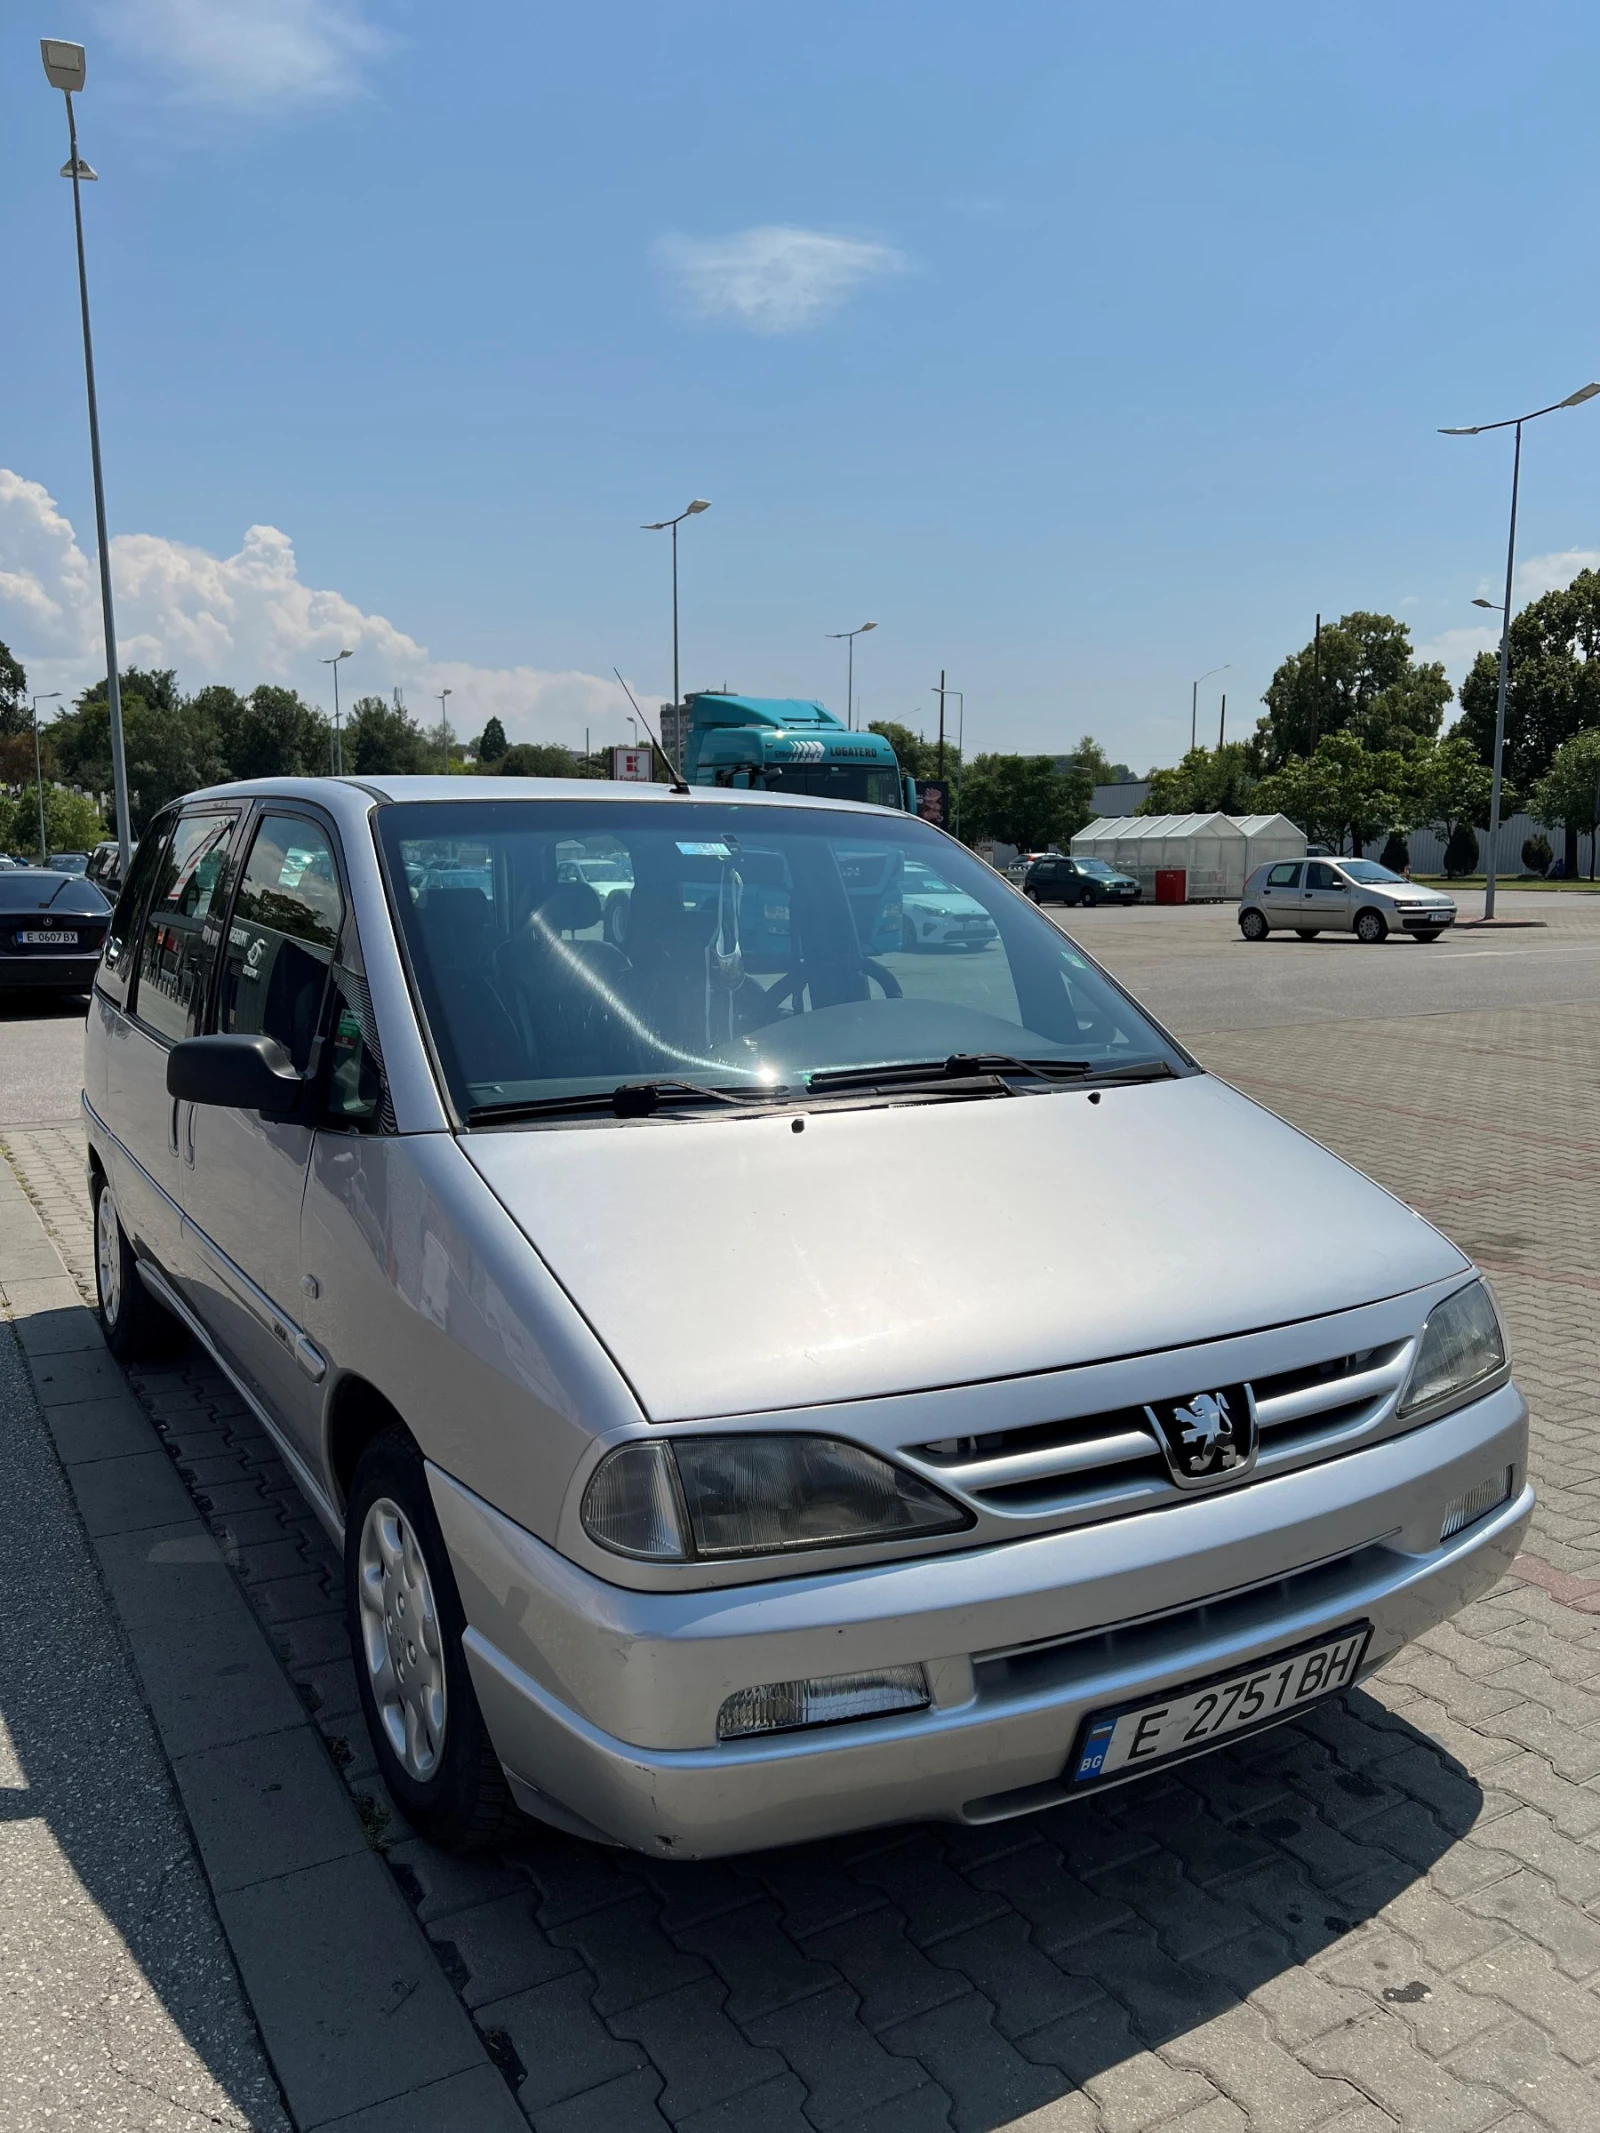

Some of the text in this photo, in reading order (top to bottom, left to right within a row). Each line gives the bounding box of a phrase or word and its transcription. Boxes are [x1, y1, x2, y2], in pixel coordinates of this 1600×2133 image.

[829, 746, 878, 758] LOGATERO
[27, 932, 77, 942] E 0607 BX
[1127, 1638, 1358, 1760] E 2751 BH
[1080, 1754, 1103, 1772] BG
